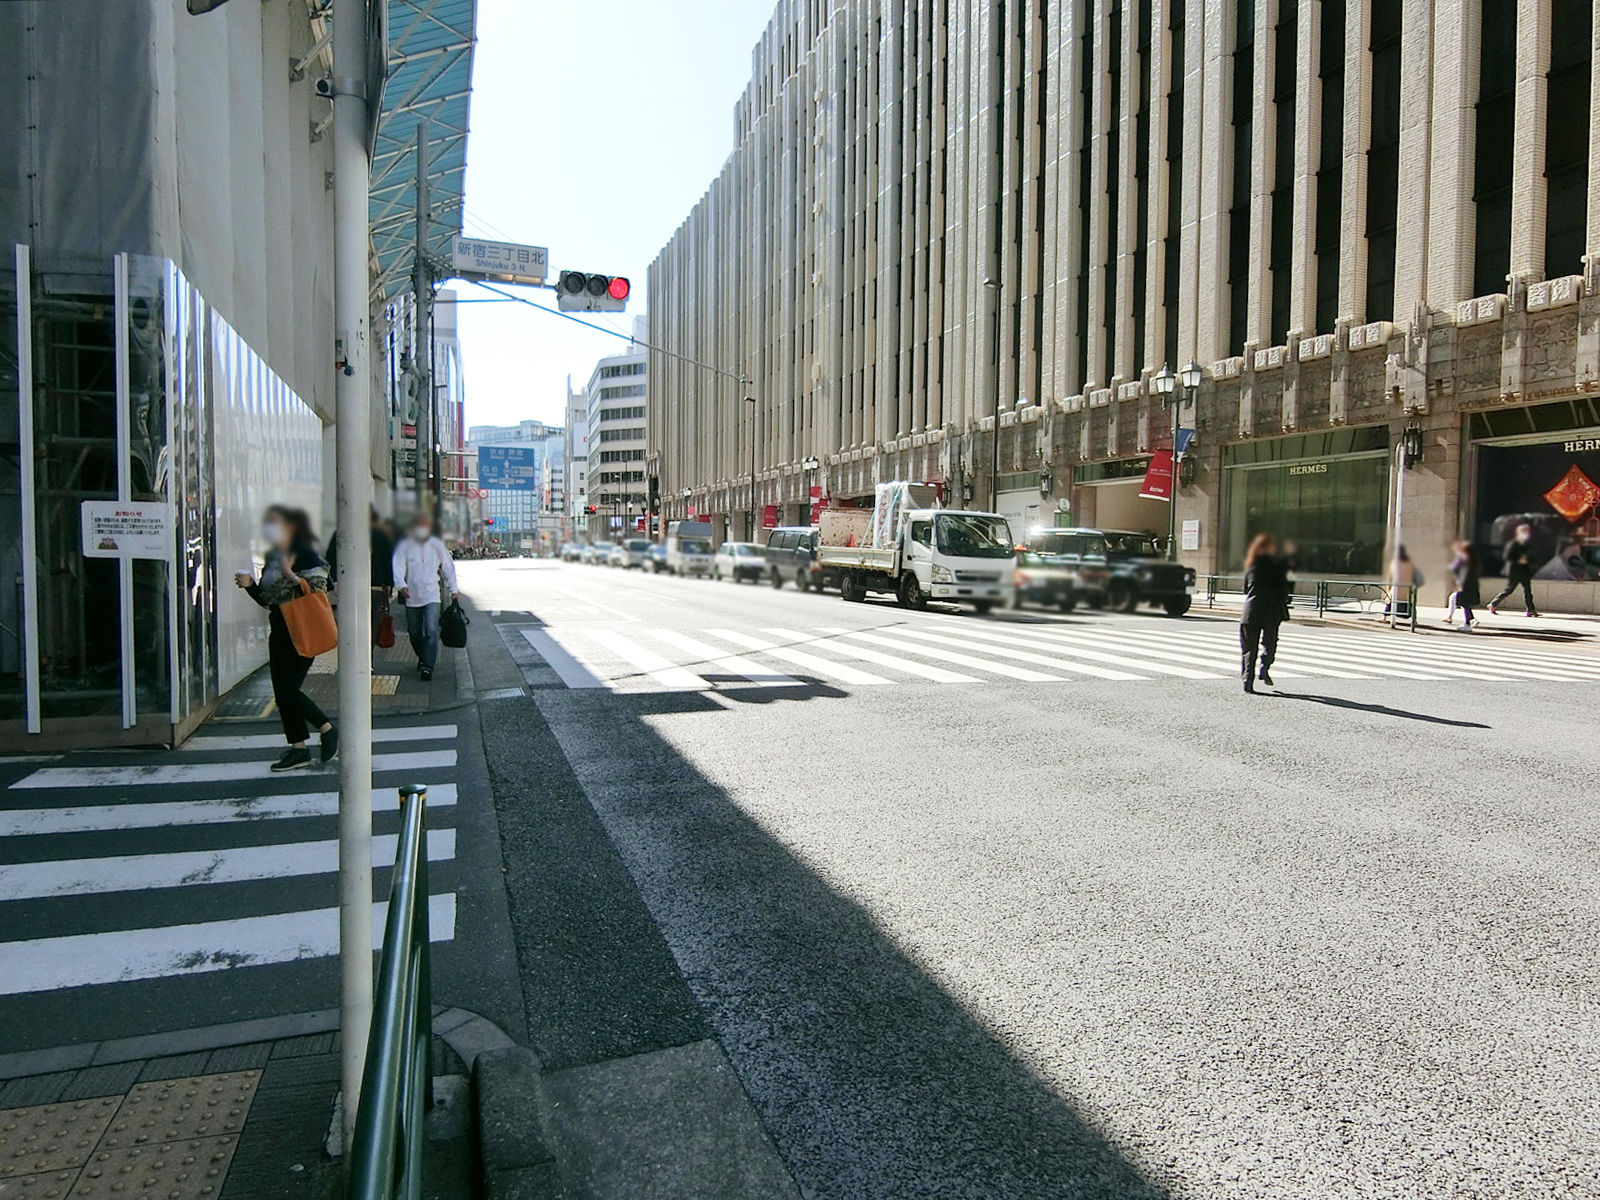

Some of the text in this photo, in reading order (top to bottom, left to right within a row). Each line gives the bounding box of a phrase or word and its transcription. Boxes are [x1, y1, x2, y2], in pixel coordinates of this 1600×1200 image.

[457, 242, 545, 265] 新宿三丁目北
[475, 258, 509, 270] Shinjuku
